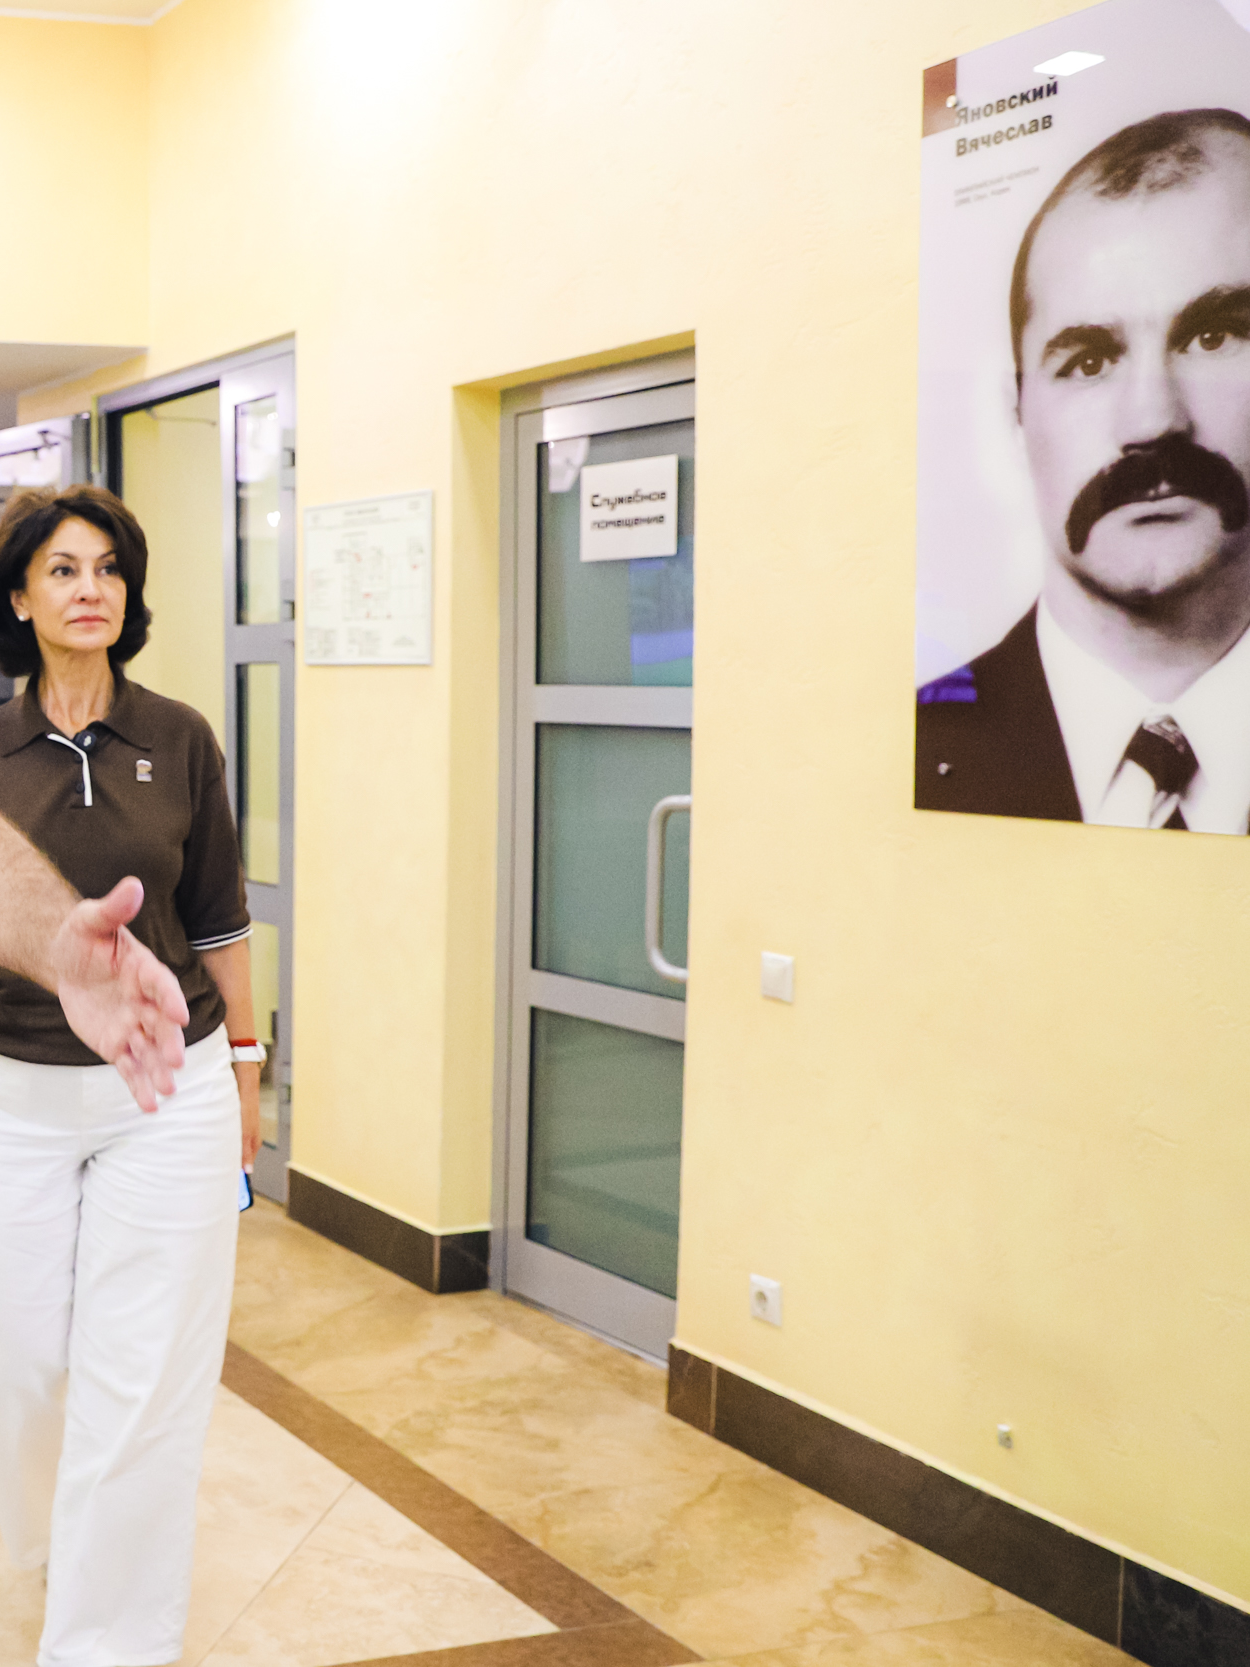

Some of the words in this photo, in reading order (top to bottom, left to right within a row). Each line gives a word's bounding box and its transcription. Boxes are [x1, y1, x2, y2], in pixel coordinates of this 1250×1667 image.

[956, 76, 1058, 126] Яновский
[955, 115, 1053, 156] Вячеслав
[591, 489, 666, 510] Служебное
[592, 515, 664, 529] помещение
